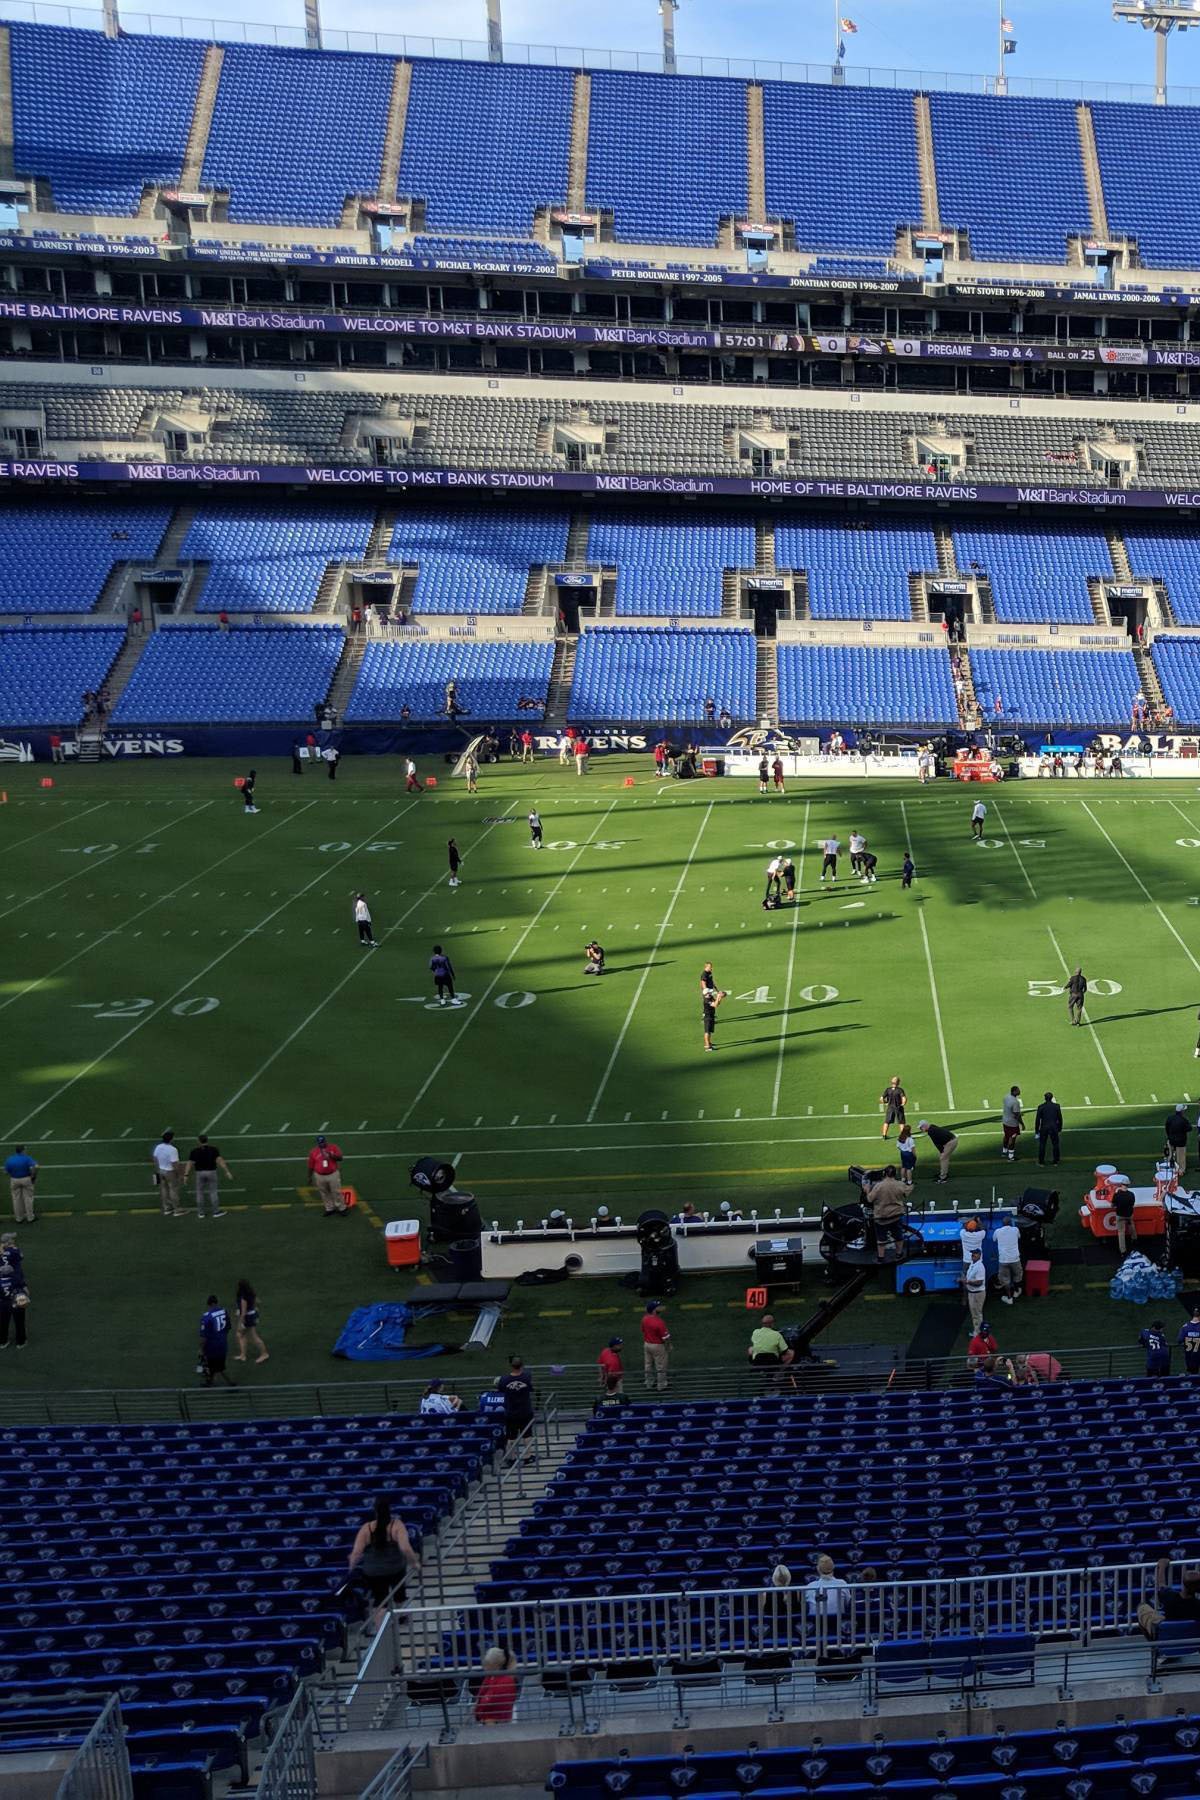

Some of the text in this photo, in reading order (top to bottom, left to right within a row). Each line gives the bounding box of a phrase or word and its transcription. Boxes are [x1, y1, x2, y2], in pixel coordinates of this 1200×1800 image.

[32, 241, 155, 255] EARNEST BYNER 1996-2003
[335, 257, 414, 267] ARTHUR B. MODELL
[436, 261, 472, 270] MICHAEL
[513, 263, 555, 274] 1997-2002
[612, 269, 722, 282] PETER BOULWARE 1997-2005
[790, 278, 898, 291] JONATHAN OGDEN 1996-2007
[956, 287, 1045, 297] MATT STOVER 1996-2008
[1073, 292, 1160, 303] JAMAL LEWIS 2000-2006
[30, 305, 119, 321] BALTIMORE
[123, 309, 181, 323] RAVENS
[202, 311, 325, 330] M&T Bank Stadium
[343, 318, 576, 339] WELCOME TO M&T BANK STADIUM
[594, 328, 706, 346] M&T Bank Stadium
[725, 335, 764, 346] 57:01
[828, 339, 837, 350] 0
[904, 343, 913, 354] 0
[927, 344, 972, 355] PREGAME
[989, 347, 1033, 358] 3RD & 4
[1048, 351, 1065, 360] BALL
[1081, 350, 1095, 360] 25
[14, 464, 78, 477] RAVENS
[128, 465, 260, 481] M&T Bank Stadium
[306, 469, 553, 487] WELCOME TO M&T BANK STADIUM
[751, 481, 977, 498] HOME OF THE BALTIMORE RAVENS
[1017, 488, 1126, 504] M&T Bank Stadium
[61, 739, 185, 757] RVENS
[749, 1289, 765, 1306] 40
[215, 1314, 227, 1332] 15
[1184, 1336, 1200, 1353] 57
